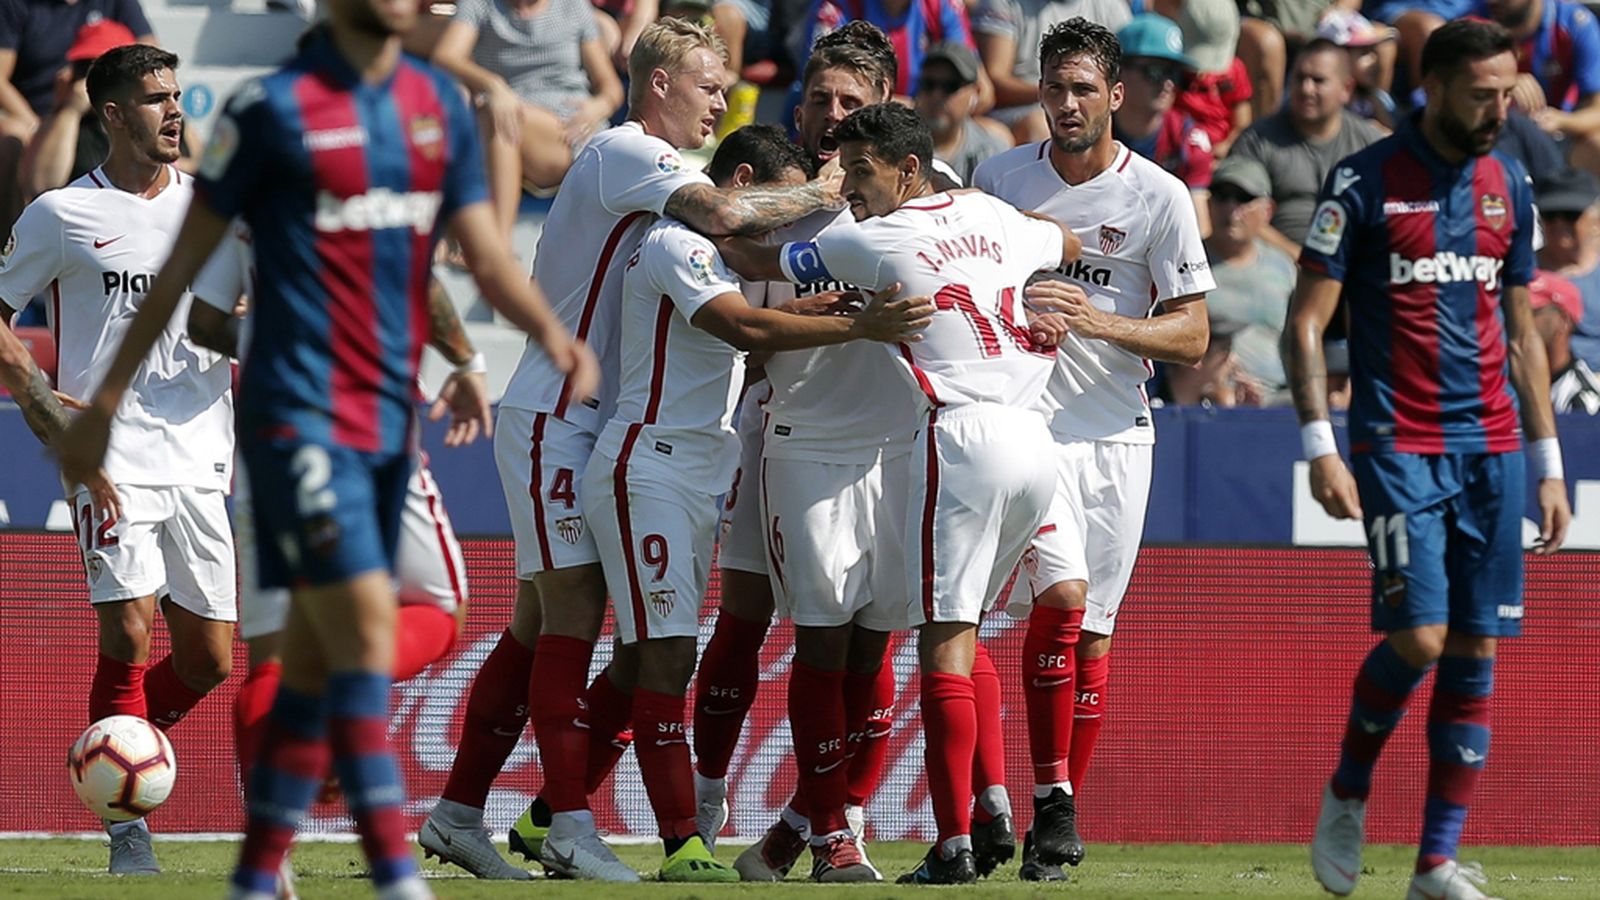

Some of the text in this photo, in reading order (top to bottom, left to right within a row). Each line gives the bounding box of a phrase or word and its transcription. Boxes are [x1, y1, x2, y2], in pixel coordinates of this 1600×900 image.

[797, 248, 818, 272] C
[916, 234, 1003, 272] J.NAVAS
[1056, 259, 1112, 287] ika
[1389, 251, 1504, 291] betway
[290, 444, 337, 518] 2
[549, 468, 576, 509] 4
[1370, 513, 1410, 570] 11
[640, 534, 669, 583] 9
[1038, 654, 1067, 669] SFC
[710, 686, 740, 699] SFC
[1072, 691, 1100, 706] SFC
[818, 738, 841, 755] SFC
